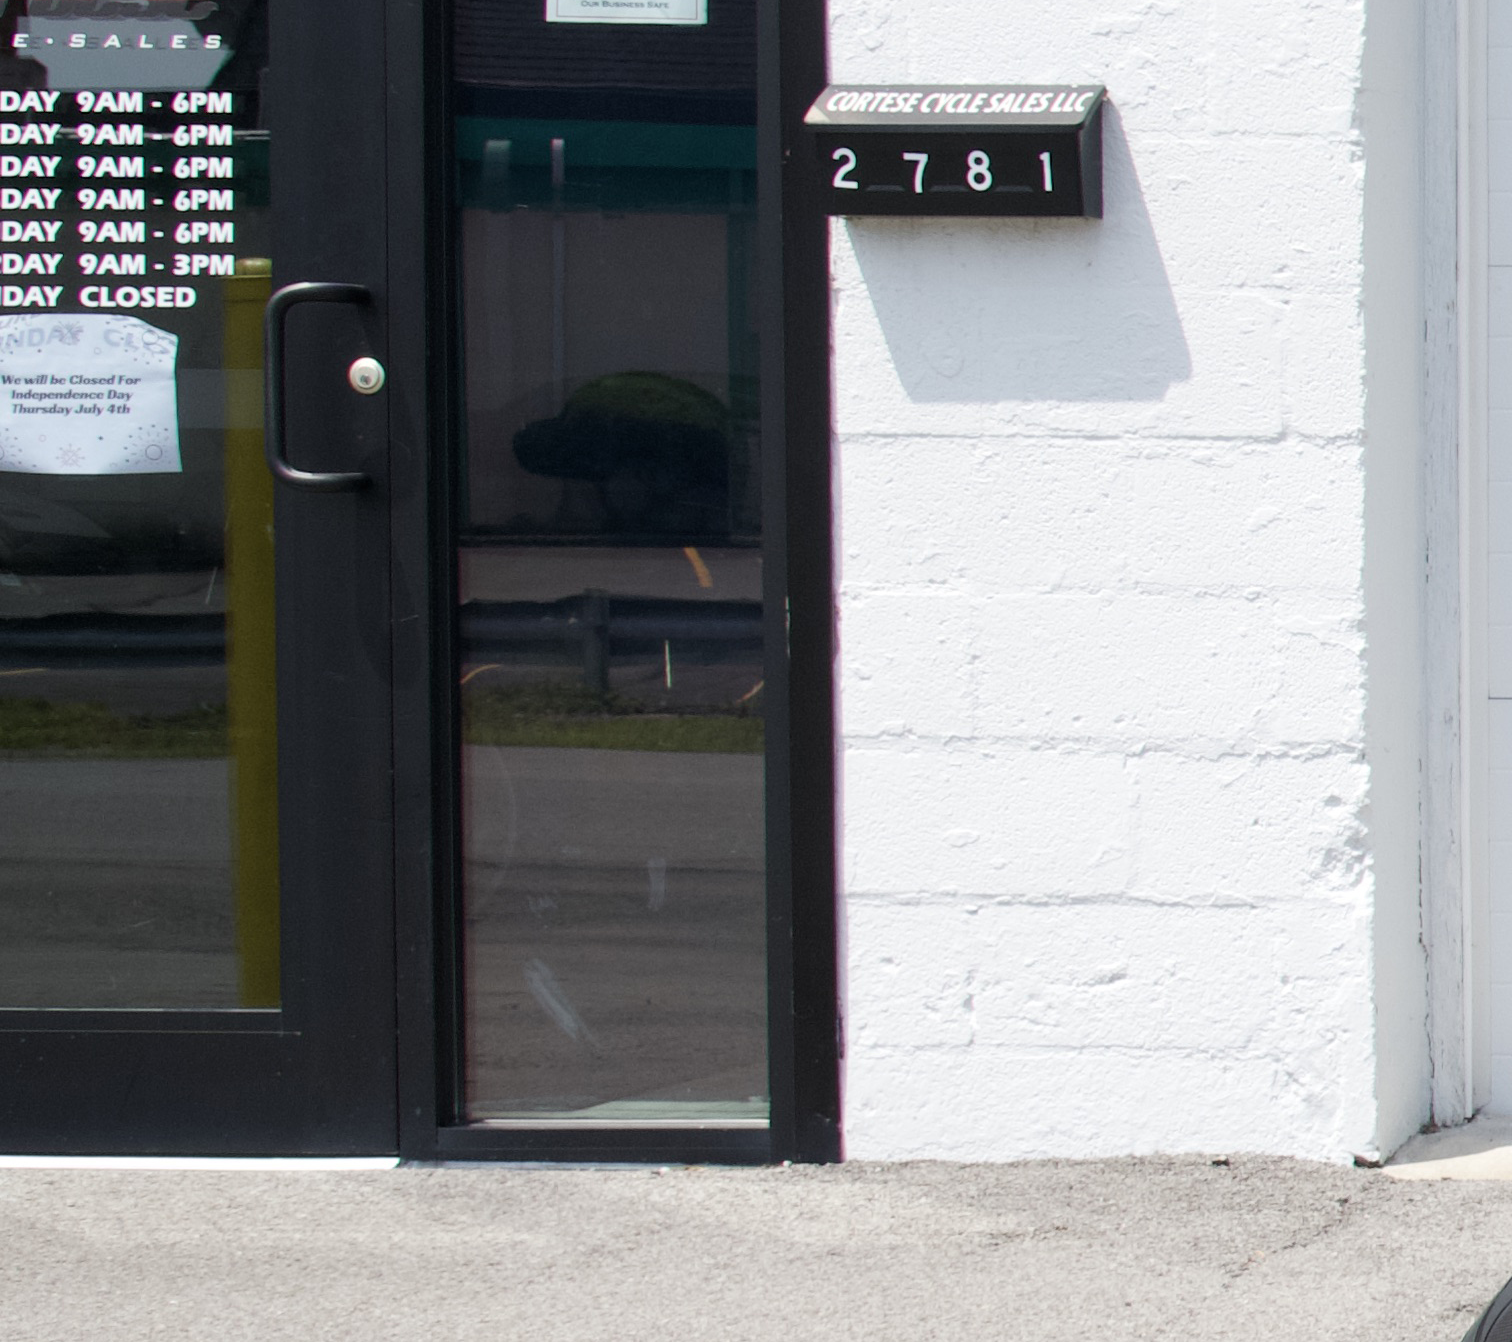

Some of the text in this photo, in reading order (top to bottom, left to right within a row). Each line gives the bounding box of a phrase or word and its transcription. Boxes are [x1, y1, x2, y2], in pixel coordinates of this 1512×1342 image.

[69, 34, 222, 49] SALES
[0, 91, 61, 112] DAY
[75, 91, 143, 113] 9AM
[172, 92, 233, 114] 6PM
[826, 91, 1094, 113] CORTESE CYCLE SALES LLC
[0, 123, 62, 145] DAY
[76, 124, 144, 146] 9AM
[172, 125, 233, 146] 6PM
[0, 156, 62, 177] DAY
[77, 156, 144, 178] 9AM
[172, 157, 233, 179] 6PM
[0, 188, 62, 210] DAY
[77, 189, 145, 210] 9AM
[173, 189, 234, 211] 6PM
[0, 221, 63, 242] DAY
[78, 221, 146, 243] 9AM
[173, 222, 234, 244] 6PM
[0, 253, 63, 275] DAY
[78, 253, 146, 275] 9AM
[172, 254, 235, 276] 3PM
[0, 286, 196, 308] DAY CLOSED
[1, 374, 141, 385] We will be Closed For
[11, 390, 133, 401] Independence Day
[12, 404, 130, 416] Thursday July 4th
